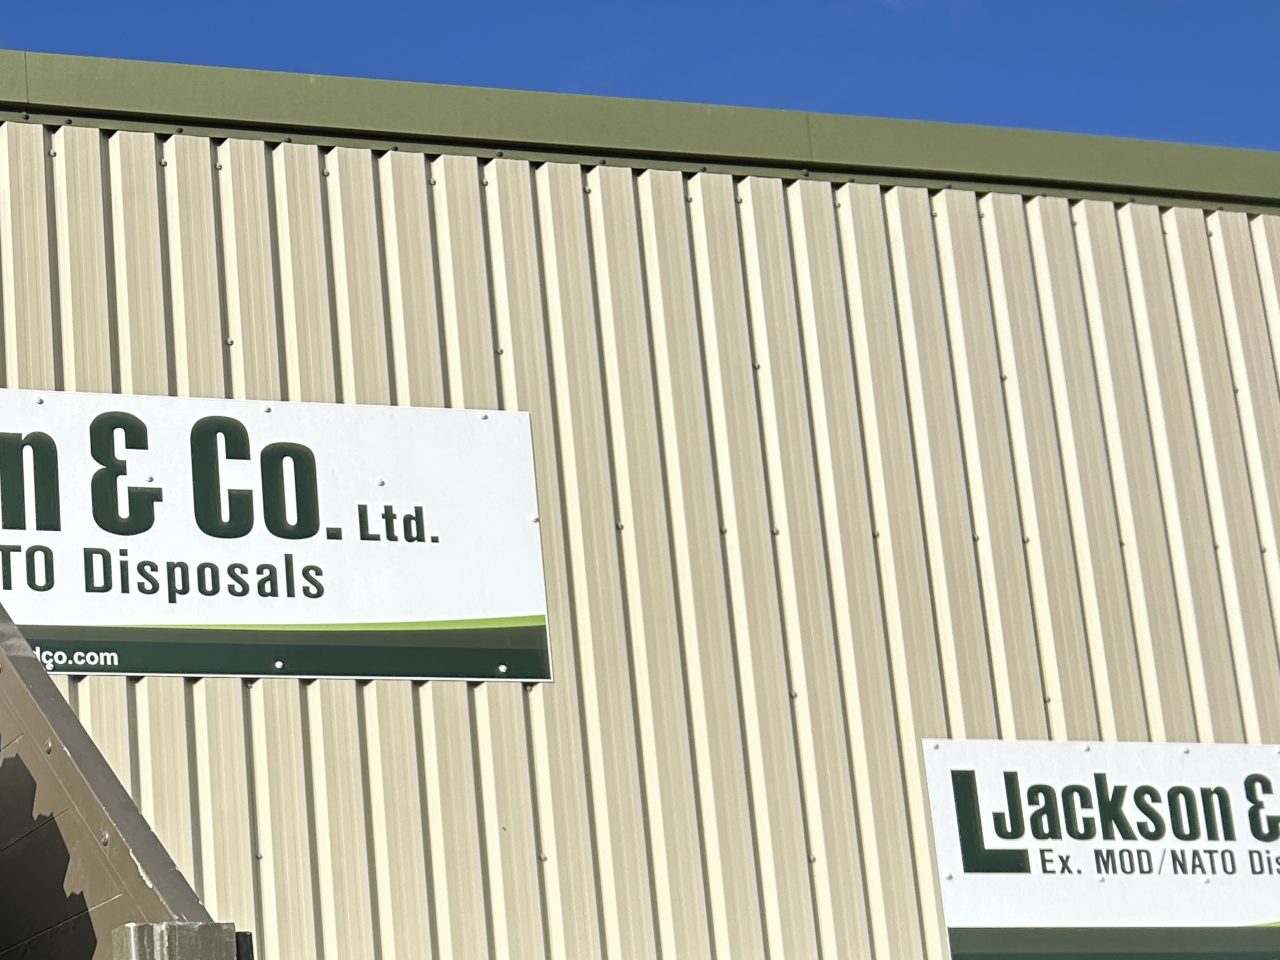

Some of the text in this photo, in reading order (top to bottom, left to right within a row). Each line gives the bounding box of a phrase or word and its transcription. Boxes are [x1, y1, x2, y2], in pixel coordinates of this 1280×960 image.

[89, 411, 163, 536] &
[190, 415, 343, 541] Co.
[357, 504, 440, 543] Ltd.
[83, 547, 325, 604] Disposals
[992, 771, 1237, 841] Jackson
[1244, 773, 1280, 843] &
[1039, 848, 1082, 875] Ex.
[1094, 848, 1237, 876] MOD/NATO
